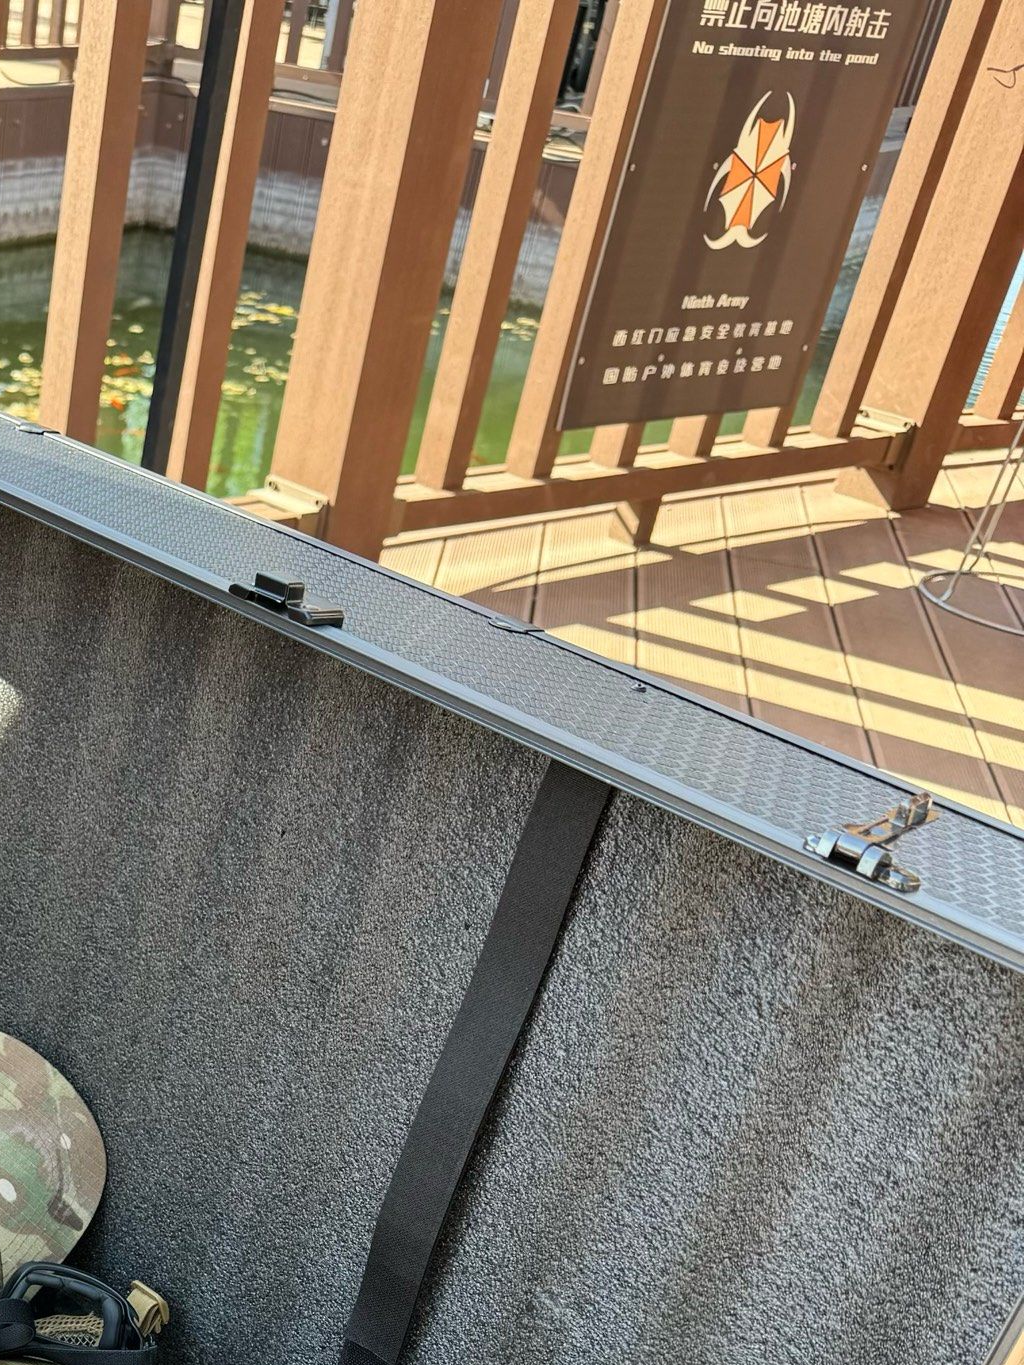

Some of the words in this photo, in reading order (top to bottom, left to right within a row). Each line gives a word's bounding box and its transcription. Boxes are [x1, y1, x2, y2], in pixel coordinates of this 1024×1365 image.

[699, 0, 892, 40] 禁止向池塘内射击
[692, 41, 715, 55] No
[718, 43, 782, 62] shooting
[785, 47, 815, 61] into
[819, 50, 842, 63] the
[845, 53, 879, 65] pond
[716, 293, 750, 310] Army
